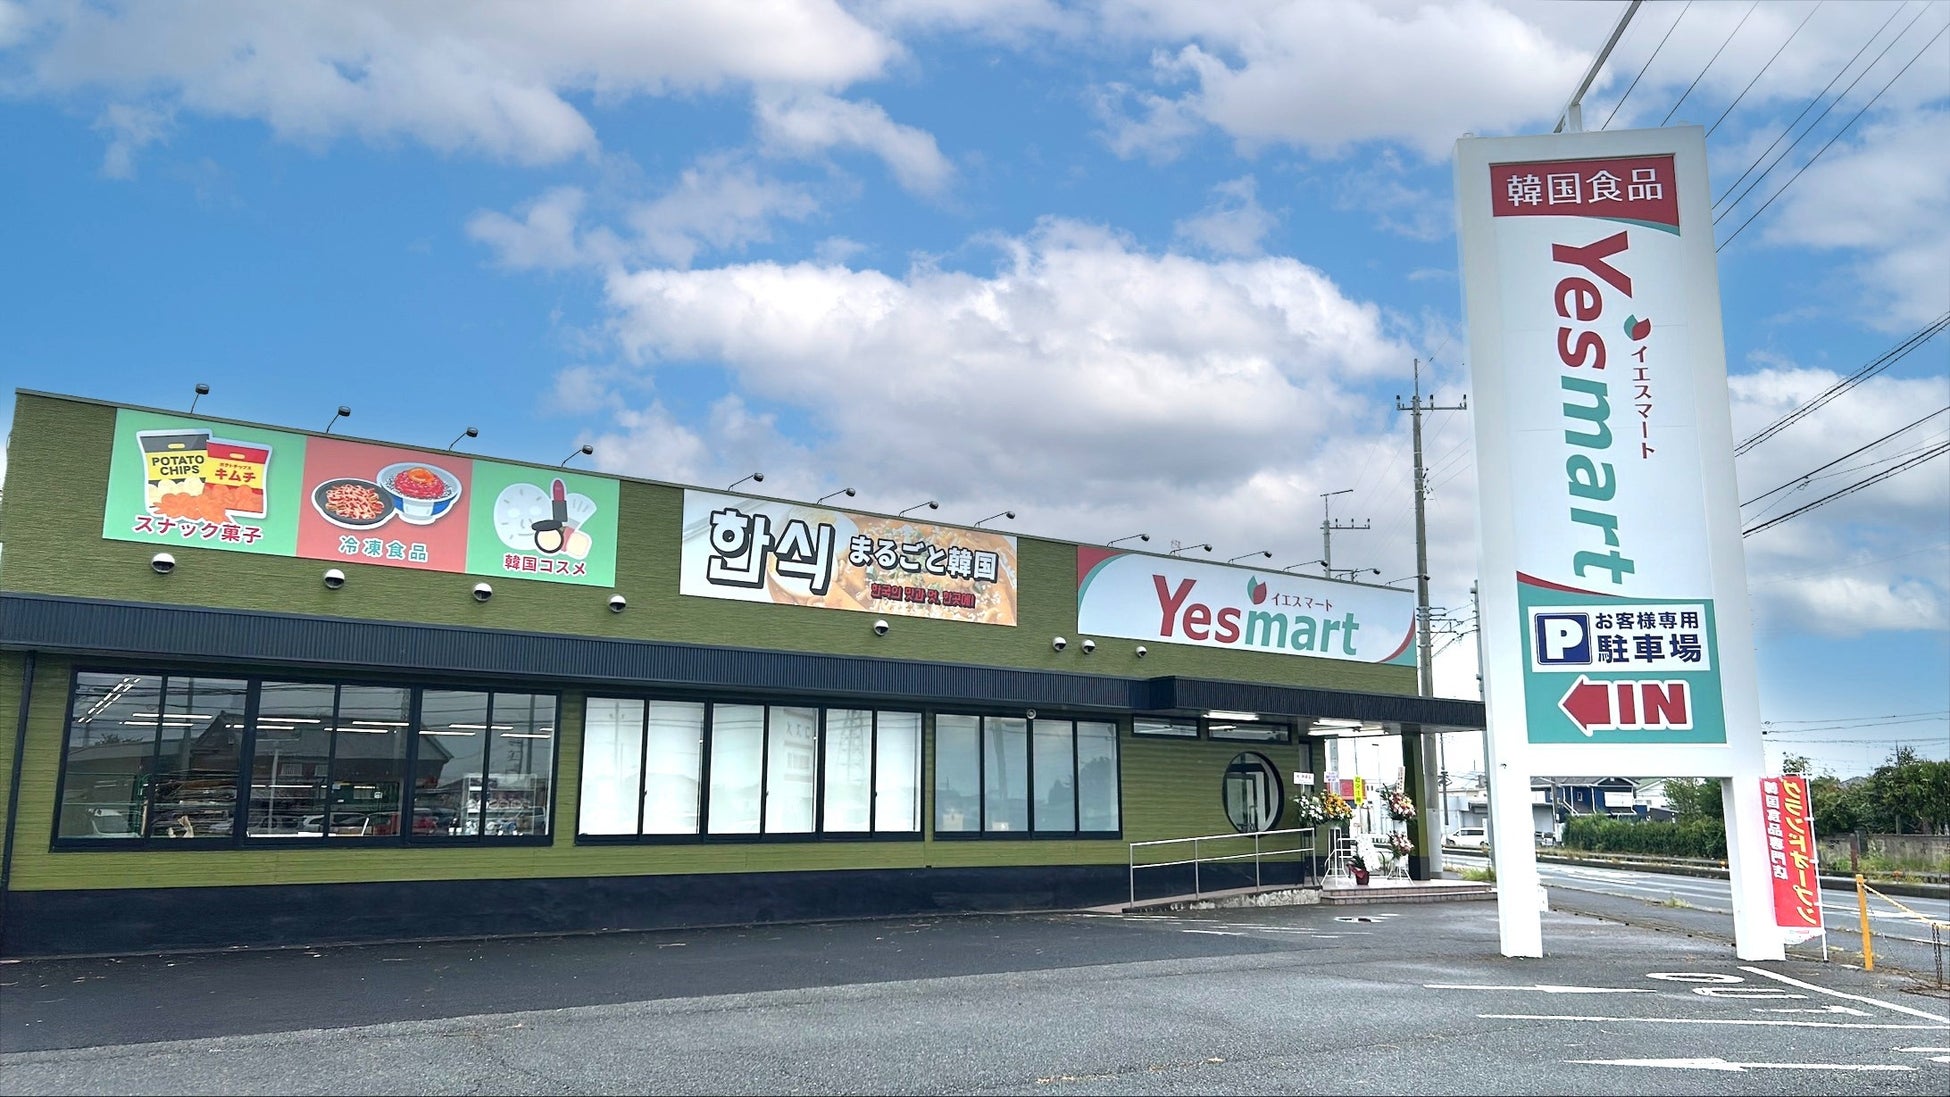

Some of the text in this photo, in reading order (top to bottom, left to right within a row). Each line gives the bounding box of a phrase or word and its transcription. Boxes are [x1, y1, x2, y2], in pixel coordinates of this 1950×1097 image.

[1507, 168, 1663, 207] 韓国食品
[1551, 230, 1635, 585] Yesmart
[1631, 345, 1655, 459] イエスマート
[152, 455, 204, 466] POTATO
[160, 465, 200, 476] CHIPS
[215, 468, 256, 482] キムチ
[134, 516, 262, 544] スナック菓子
[339, 536, 428, 562] 冷凍食品
[707, 508, 836, 596] 한식
[849, 534, 999, 584] まるごと韓国
[503, 553, 587, 577] 韓国コスメ
[871, 583, 903, 601] 한국의
[905, 587, 926, 603] 맛과
[1271, 593, 1333, 612] イエスマート
[1152, 574, 1360, 656] Yesmart
[1595, 611, 1699, 630] お客様専用
[1544, 617, 1584, 660] P
[1597, 633, 1702, 663] 駐車場
[1616, 682, 1688, 725] IN
